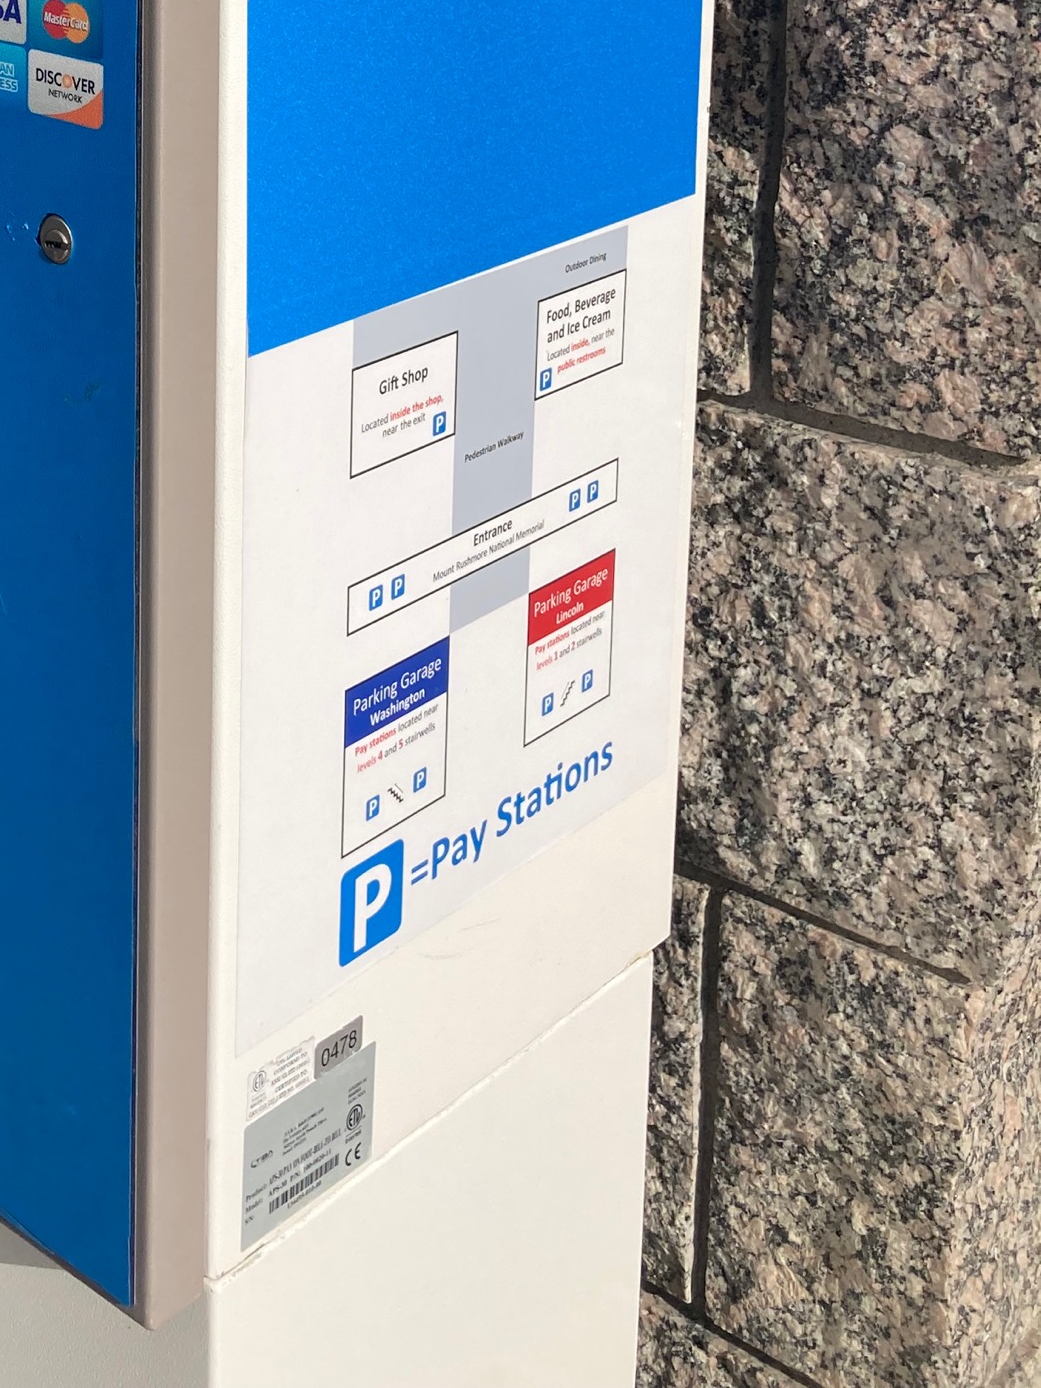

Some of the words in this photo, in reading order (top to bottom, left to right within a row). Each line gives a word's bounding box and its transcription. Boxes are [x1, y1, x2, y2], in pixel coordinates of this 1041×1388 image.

[43, 11, 89, 31] MasterCard
[35, 68, 96, 94] DISCOVER
[48, 88, 82, 103] NETWORK
[565, 259, 588, 273] Outdoor
[589, 252, 607, 264] Dining
[546, 302, 572, 324] Food,
[575, 288, 616, 314] Beverage
[547, 323, 565, 343] and
[567, 322, 580, 336] Ice
[582, 310, 611, 328] Cream
[547, 344, 570, 361] Located
[570, 338, 590, 352] inside,
[591, 331, 604, 343] near
[605, 328, 615, 339] the
[557, 357, 575, 374] public
[576, 347, 606, 364] restrooms
[379, 376, 399, 395] Gift
[402, 367, 429, 387] Shop
[361, 414, 389, 433] Located
[390, 407, 411, 422] inside
[412, 401, 424, 413] the
[425, 394, 443, 409] shop,
[382, 424, 398, 438] near
[400, 420, 412, 431] the
[413, 413, 426, 426] exit
[464, 443, 496, 463] Pedestrian
[497, 431, 524, 448] Walkway
[473, 519, 513, 547] Entrance
[433, 565, 455, 583] Mount
[456, 549, 487, 573] Rushmore
[489, 537, 515, 555] National
[515, 519, 545, 543] Memorial
[533, 588, 571, 617] Parking
[573, 568, 609, 595] Garage
[556, 601, 584, 624] Lincoln
[534, 644, 546, 656] Pay
[546, 631, 570, 649] stations
[570, 616, 591, 635] located
[592, 610, 605, 624] near
[536, 655, 553, 671] levels
[559, 646, 570, 658] and
[570, 642, 576, 653] 2
[576, 627, 602, 648] stairwells
[353, 682, 398, 716] Parking
[400, 658, 442, 689] Garage
[370, 688, 425, 727] Washington
[354, 744, 368, 757] Pay
[369, 727, 396, 749] stations
[398, 713, 422, 733] located
[423, 704, 439, 719] near
[357, 755, 377, 773] levels
[377, 749, 383, 761] 4
[384, 743, 398, 758] and
[398, 739, 404, 750] 5
[404, 722, 436, 747] stairwells
[496, 741, 614, 838] Stations
[321, 1030, 357, 1066] 0478
